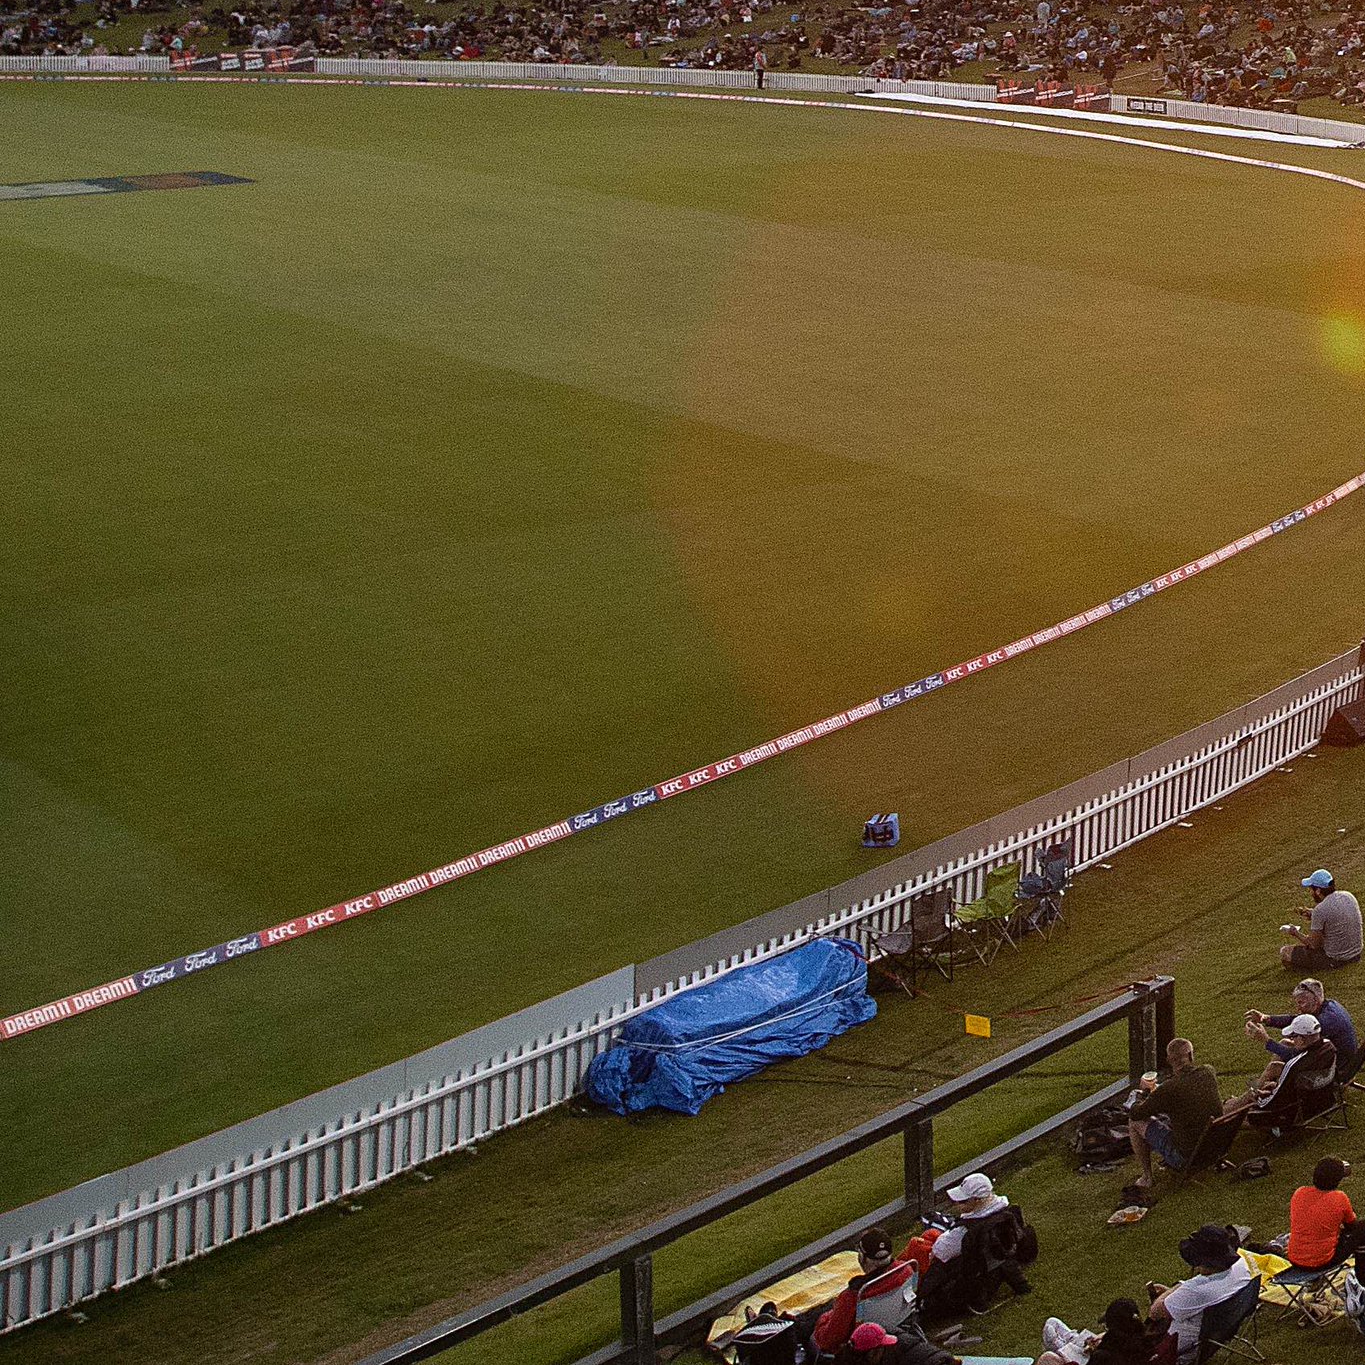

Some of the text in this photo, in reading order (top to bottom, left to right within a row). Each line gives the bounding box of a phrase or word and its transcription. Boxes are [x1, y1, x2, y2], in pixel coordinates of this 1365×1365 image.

[946, 650, 1004, 681] KFC KFC KFC
[883, 675, 943, 707] Ford Ford Ford
[740, 700, 882, 765] DREAM11 DREAM11 DREAM11 DREAM11
[661, 759, 737, 796] KFC KFC KFC
[574, 790, 657, 830] Ford Ford Ford
[378, 821, 572, 904] DREAM11 DREAM11 DREAM11 DREAM11
[267, 896, 374, 942] KFC KFC KFC
[142, 936, 259, 987] Ford Ford Ford
[4, 977, 138, 1035] DREAM11 DREAM11
